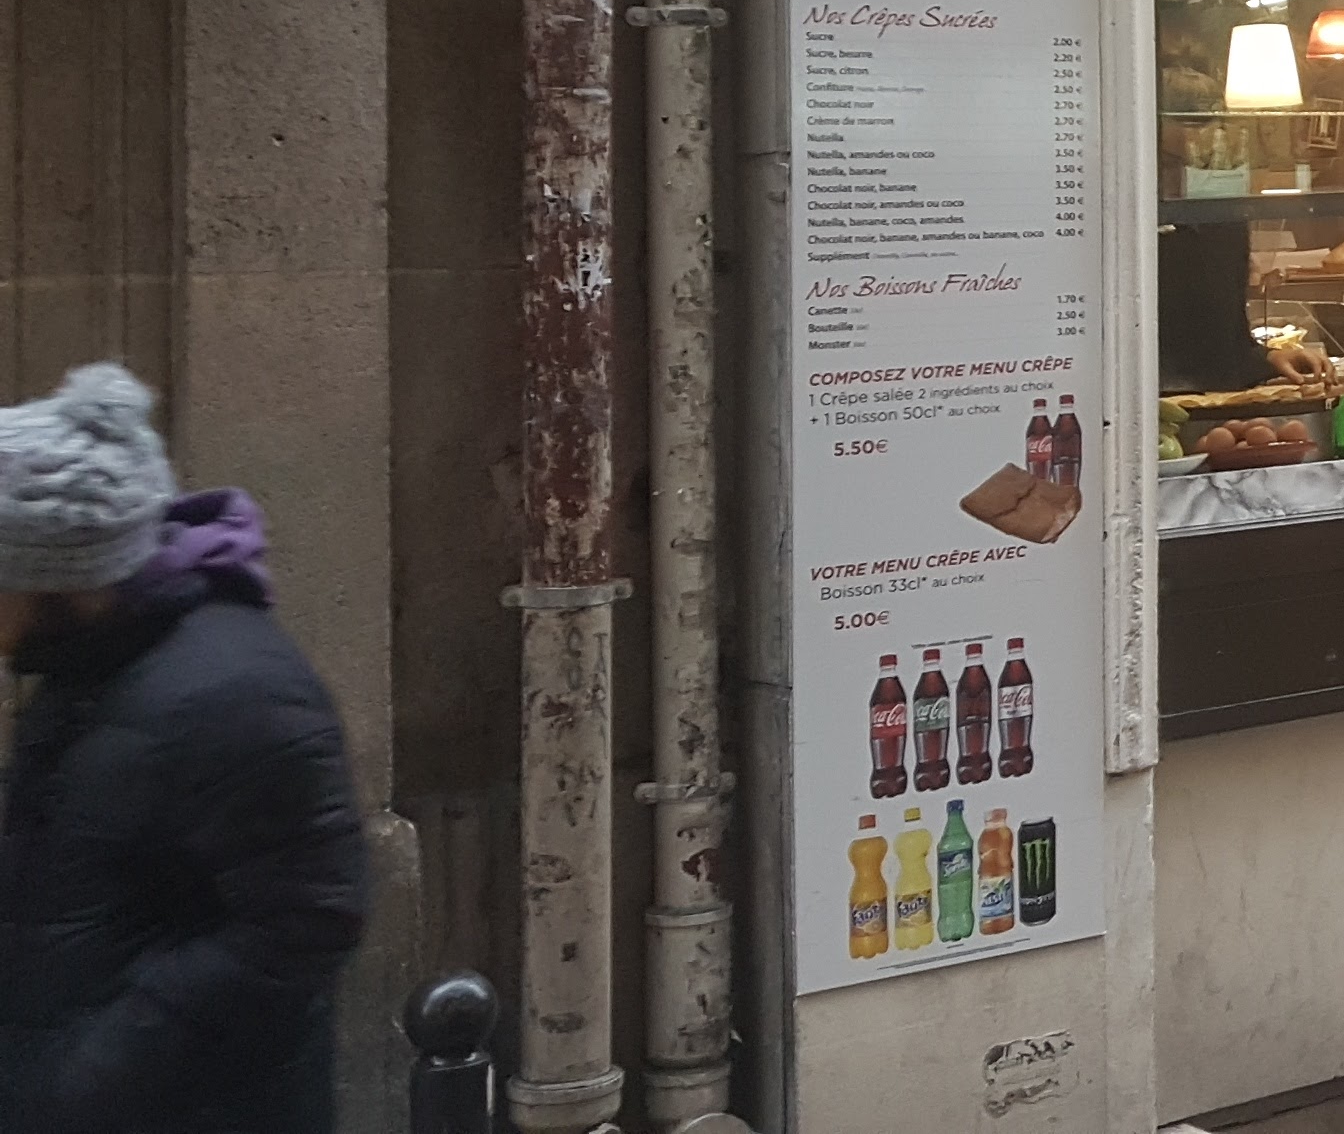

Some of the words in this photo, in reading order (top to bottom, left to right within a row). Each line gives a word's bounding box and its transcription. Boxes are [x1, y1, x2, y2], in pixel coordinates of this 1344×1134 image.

[803, 3, 848, 26] Nos
[850, 3, 916, 40] Crêpes
[918, 5, 1000, 30] Sucrées
[804, 276, 851, 301] Nos
[852, 274, 938, 298] Boissons
[940, 262, 1023, 294] Fraîches
[808, 367, 907, 387] COMPOSEZ
[909, 364, 965, 381] VOTRE
[968, 360, 1018, 376] MENU
[1020, 355, 1075, 373] CRÊPE
[819, 390, 869, 410] Crêpe
[872, 386, 914, 402] salée
[916, 388, 926, 400] 2
[1002, 384, 1019, 394] au
[834, 409, 899, 426] Boisson
[947, 406, 964, 418] au
[832, 438, 889, 458] 5.50€
[809, 562, 868, 582] VOTRE
[870, 556, 922, 575] MENU
[925, 549, 981, 569] CRÊPE
[983, 544, 1029, 562] AVEC
[820, 581, 884, 602] Boisson
[931, 577, 949, 588] au
[833, 609, 891, 631] 5.00€
